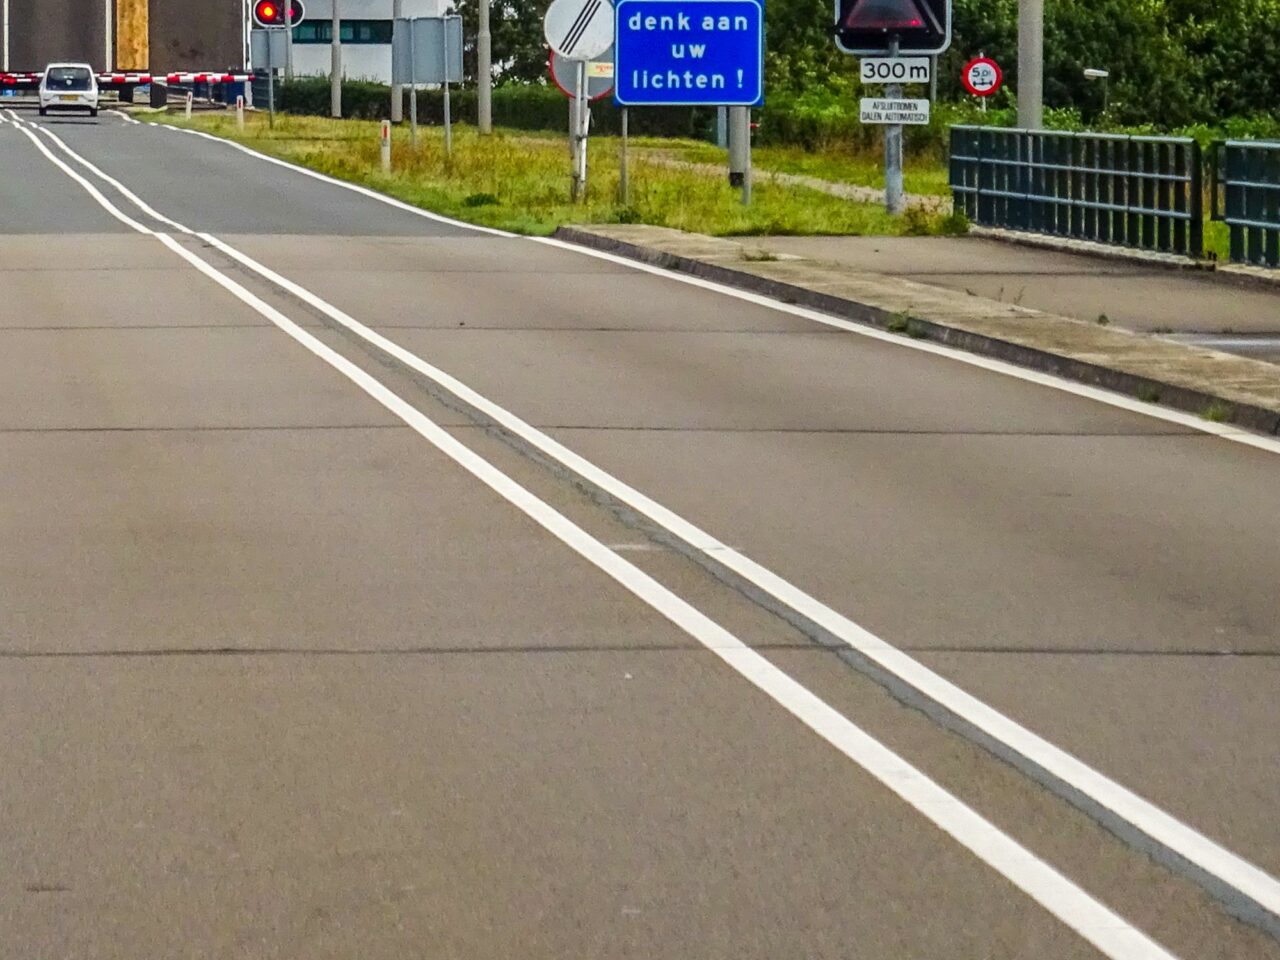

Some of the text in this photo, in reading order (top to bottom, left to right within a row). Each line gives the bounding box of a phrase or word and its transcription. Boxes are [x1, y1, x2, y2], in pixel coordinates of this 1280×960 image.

[628, 12, 748, 31] denk aan
[672, 44, 706, 59] uw
[863, 62, 928, 79] 300 m
[632, 69, 744, 89] lichten !
[872, 101, 918, 111] AFSLUITBOMEN
[862, 111, 928, 122] DALEN AUTOMATISCH
